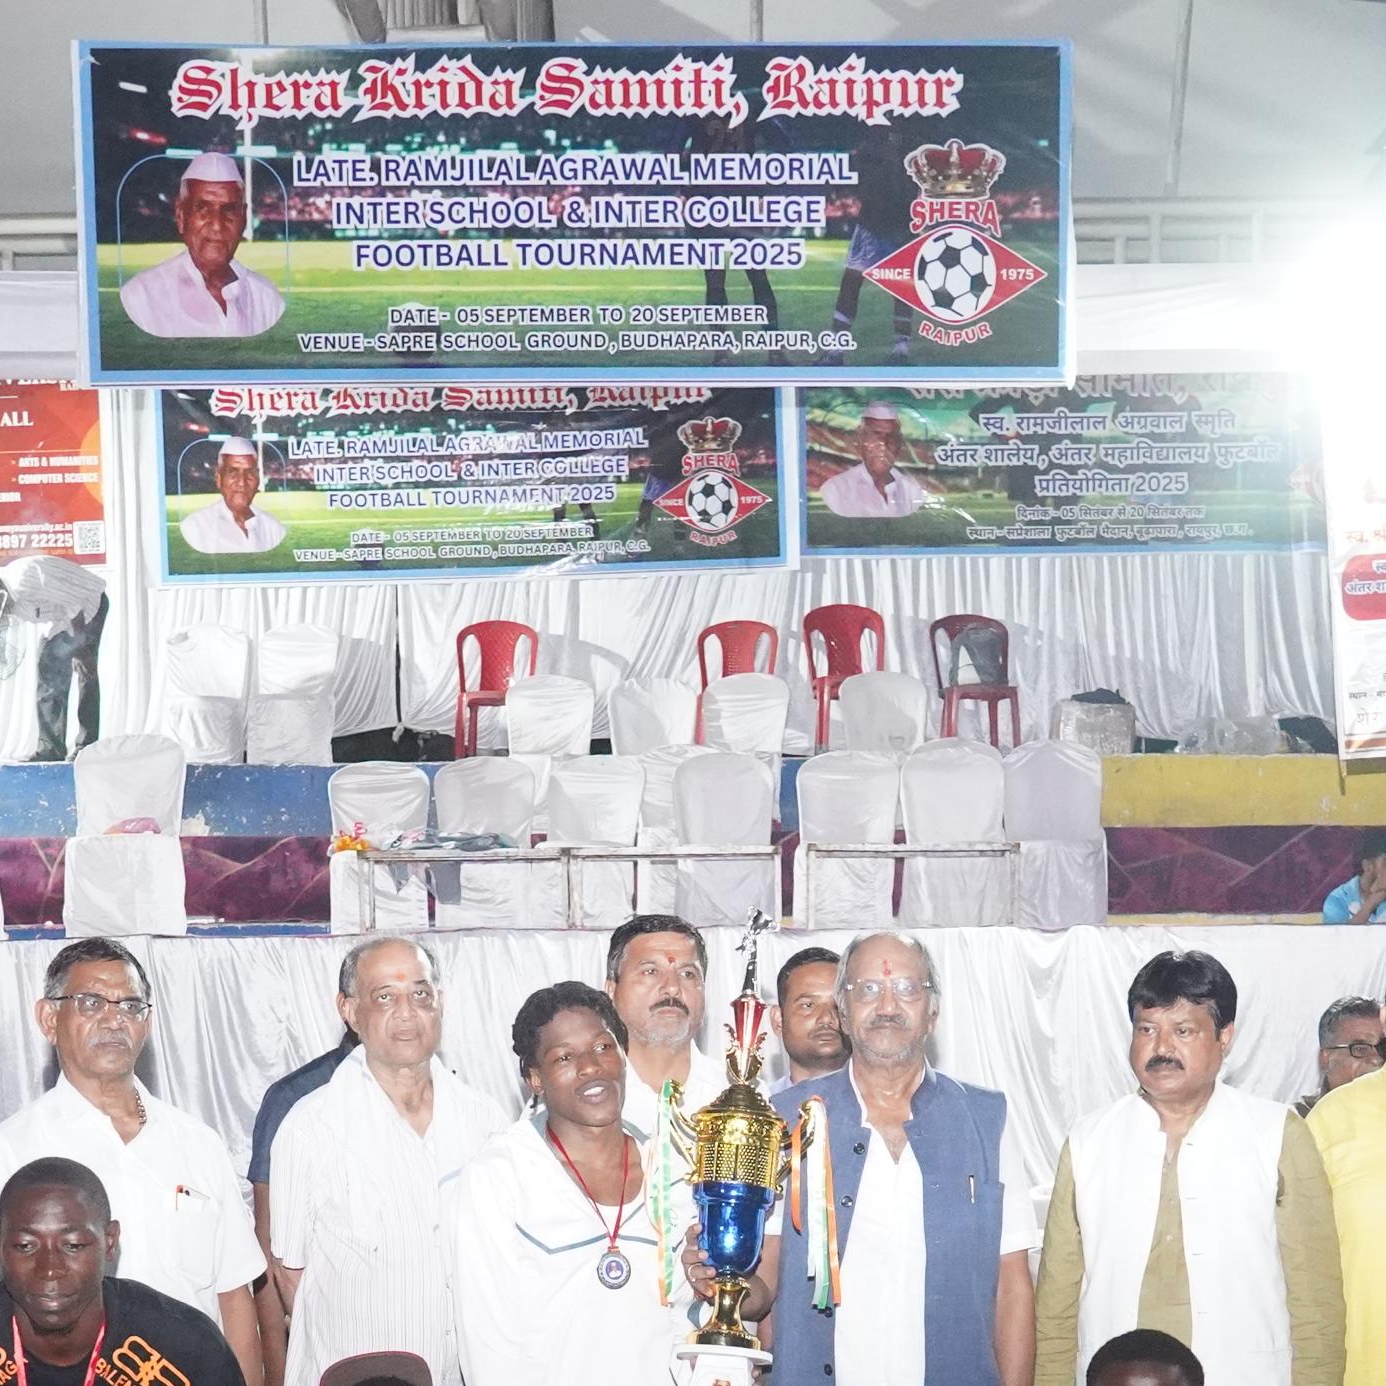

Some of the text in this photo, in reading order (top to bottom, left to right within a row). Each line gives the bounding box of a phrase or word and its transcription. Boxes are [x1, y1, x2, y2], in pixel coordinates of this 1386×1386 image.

[172, 56, 960, 126] Shera Krida Samiti, Raipur
[295, 156, 853, 184] LATE. RAMJILAL AGRAWAL MEMORIAL
[334, 199, 823, 226] INTER SCHOOL & INTER COLLEGE
[910, 200, 1001, 237] SHERA
[355, 241, 803, 268] FOOTBALL TOURNAMENT 2025
[871, 268, 912, 280] SINCE
[999, 268, 1034, 281] 1975
[456, 308, 479, 324] 05
[484, 307, 591, 324] SEPTEMBER
[599, 307, 623, 323] TO
[631, 307, 654, 323] 20
[659, 307, 768, 323] SEPTEMBER
[443, 334, 519, 350] SCHOOL
[919, 321, 992, 345] RAIPUR
[0, 410, 35, 427] ALL
[1015, 410, 1108, 433] रामजीलाल
[1117, 411, 1186, 433] अग्रवाल
[289, 429, 645, 457] LATE. RAMJILAL AGRAWAL MEMORIAL
[936, 441, 978, 463] अंतर
[1050, 441, 1093, 463] अंतर
[315, 458, 627, 483] INTER SCHOOL & INTER COLLEGE
[681, 453, 740, 475] SHERA
[1135, 474, 1186, 493] 2025
[328, 485, 615, 509] FOOTBALL TOURNAMENT 2025
[740, 495, 763, 505] 1975
[1060, 506, 1076, 519] 05
[1129, 506, 1144, 519] 20
[31, 533, 73, 548] 22225
[412, 529, 480, 543] SEPTEMBER
[485, 529, 501, 541] TO
[506, 528, 523, 541] 20
[524, 526, 594, 540] SEPTEMBER
[689, 530, 738, 546] RAIPUR
[386, 547, 434, 559] SCHOOL
